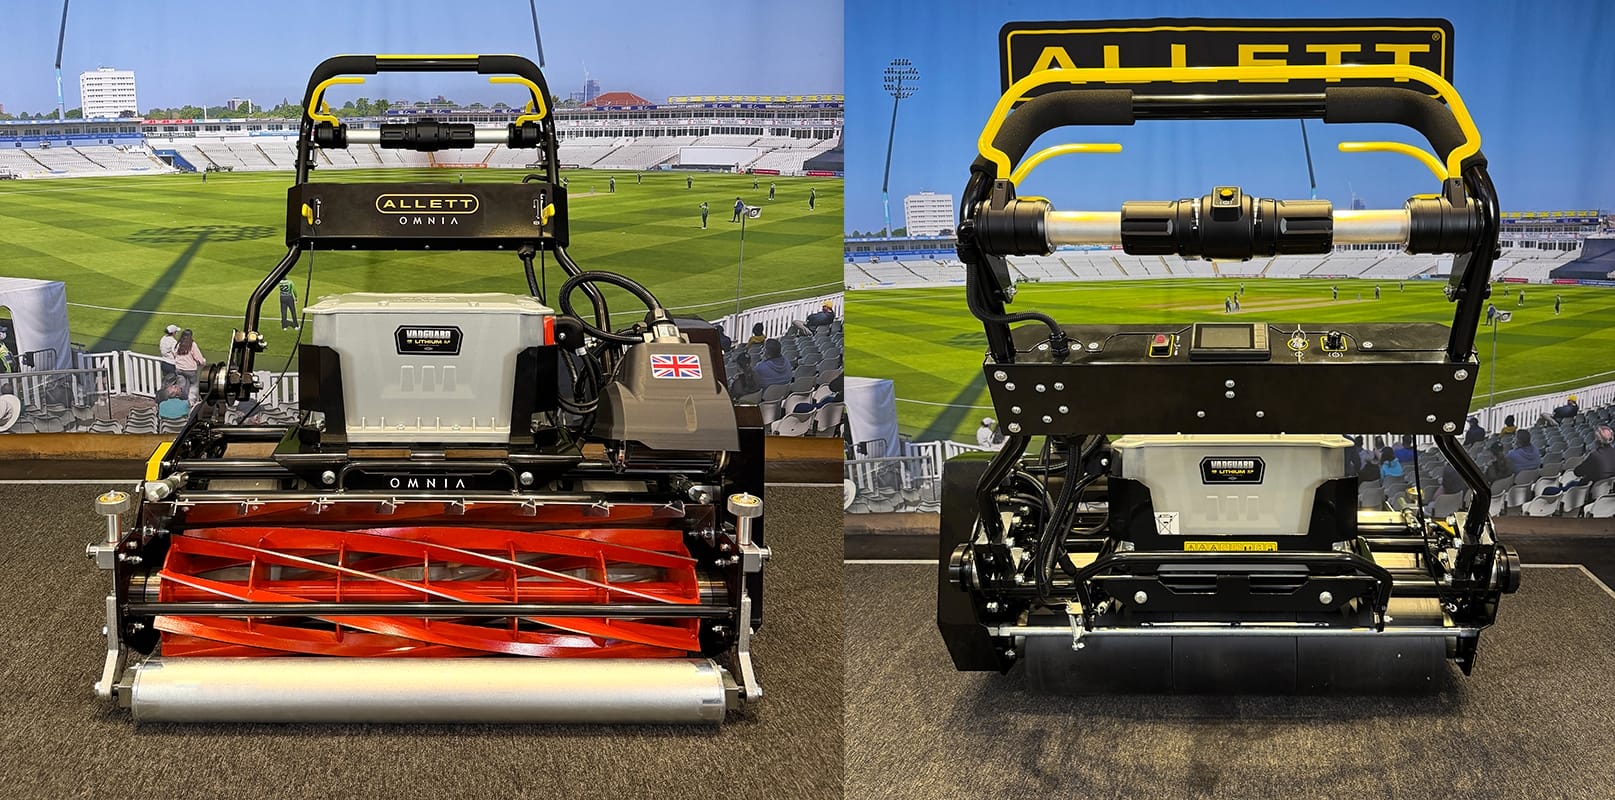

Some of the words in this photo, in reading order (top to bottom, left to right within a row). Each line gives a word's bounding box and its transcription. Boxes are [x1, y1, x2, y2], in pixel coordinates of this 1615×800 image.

[383, 199, 473, 209] ALLETT
[399, 216, 459, 225] OMNIA
[406, 329, 451, 339] VANGUARD
[1210, 460, 1254, 469] VANGUARD
[389, 477, 465, 489] OMNIA
